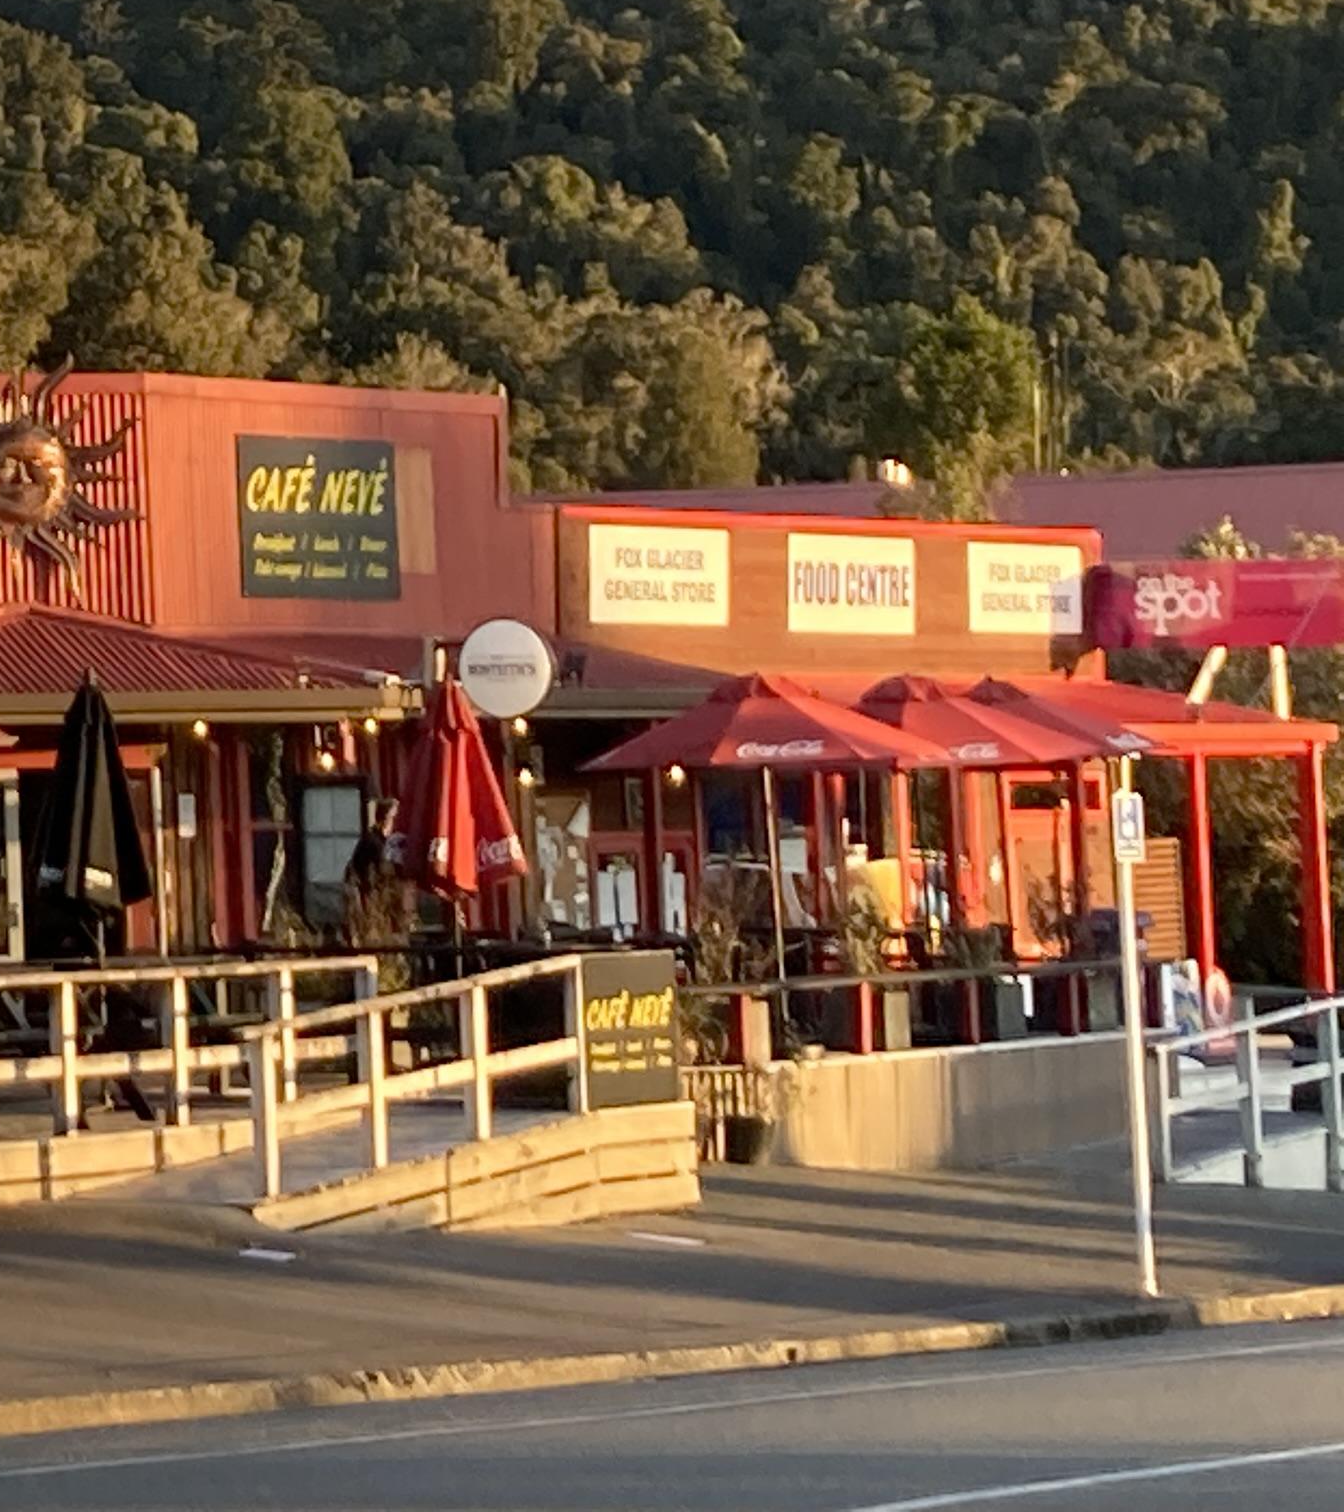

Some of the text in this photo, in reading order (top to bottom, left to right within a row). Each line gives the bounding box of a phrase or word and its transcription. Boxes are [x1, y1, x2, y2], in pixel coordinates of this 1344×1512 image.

[246, 454, 388, 516] CAFÉ NEVÉ
[615, 547, 704, 571] FOX GLACIER
[604, 578, 716, 603] GENERAL STORE
[794, 561, 910, 607] FOOD CENTRE
[1136, 573, 1196, 592] on the
[1134, 579, 1223, 637] spot
